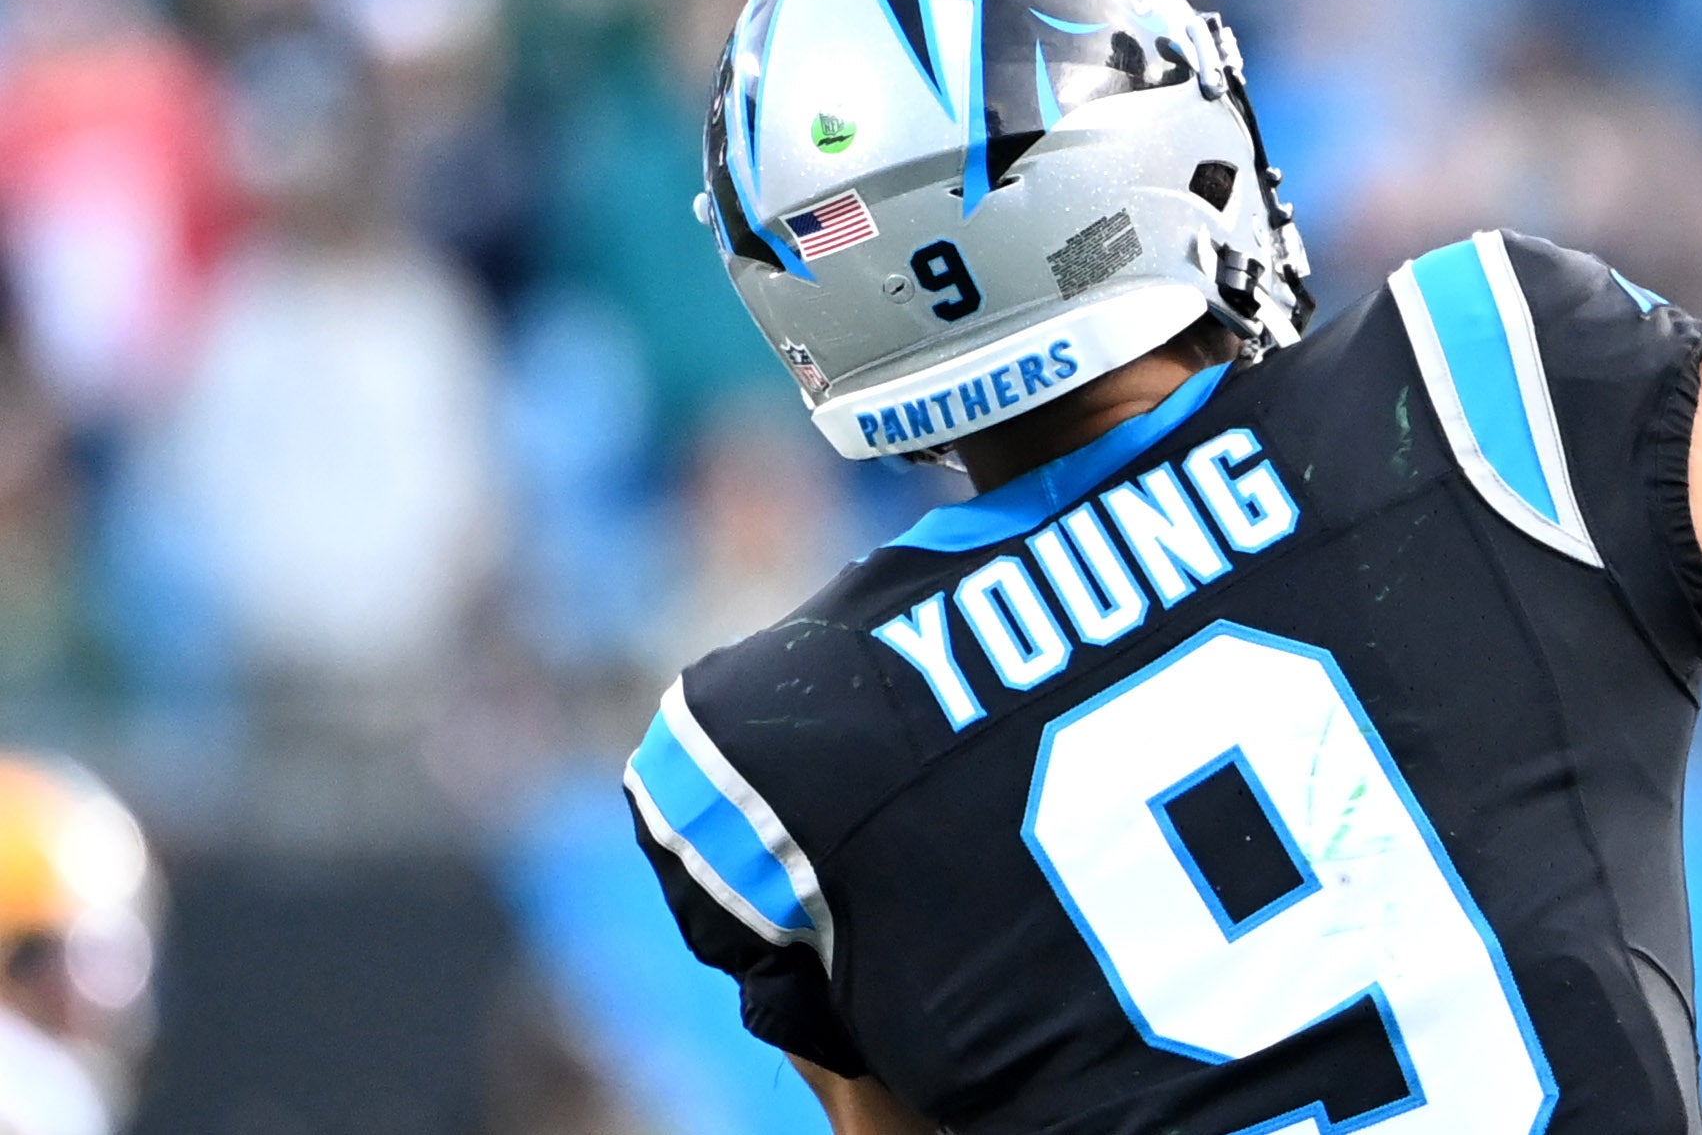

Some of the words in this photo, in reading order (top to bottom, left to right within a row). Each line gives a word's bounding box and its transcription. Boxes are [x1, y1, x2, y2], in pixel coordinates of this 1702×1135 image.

[908, 238, 984, 323] 9
[855, 338, 1078, 447] PANTHERS
[871, 427, 1300, 732] YOUNG
[1020, 618, 1559, 1135] 9
